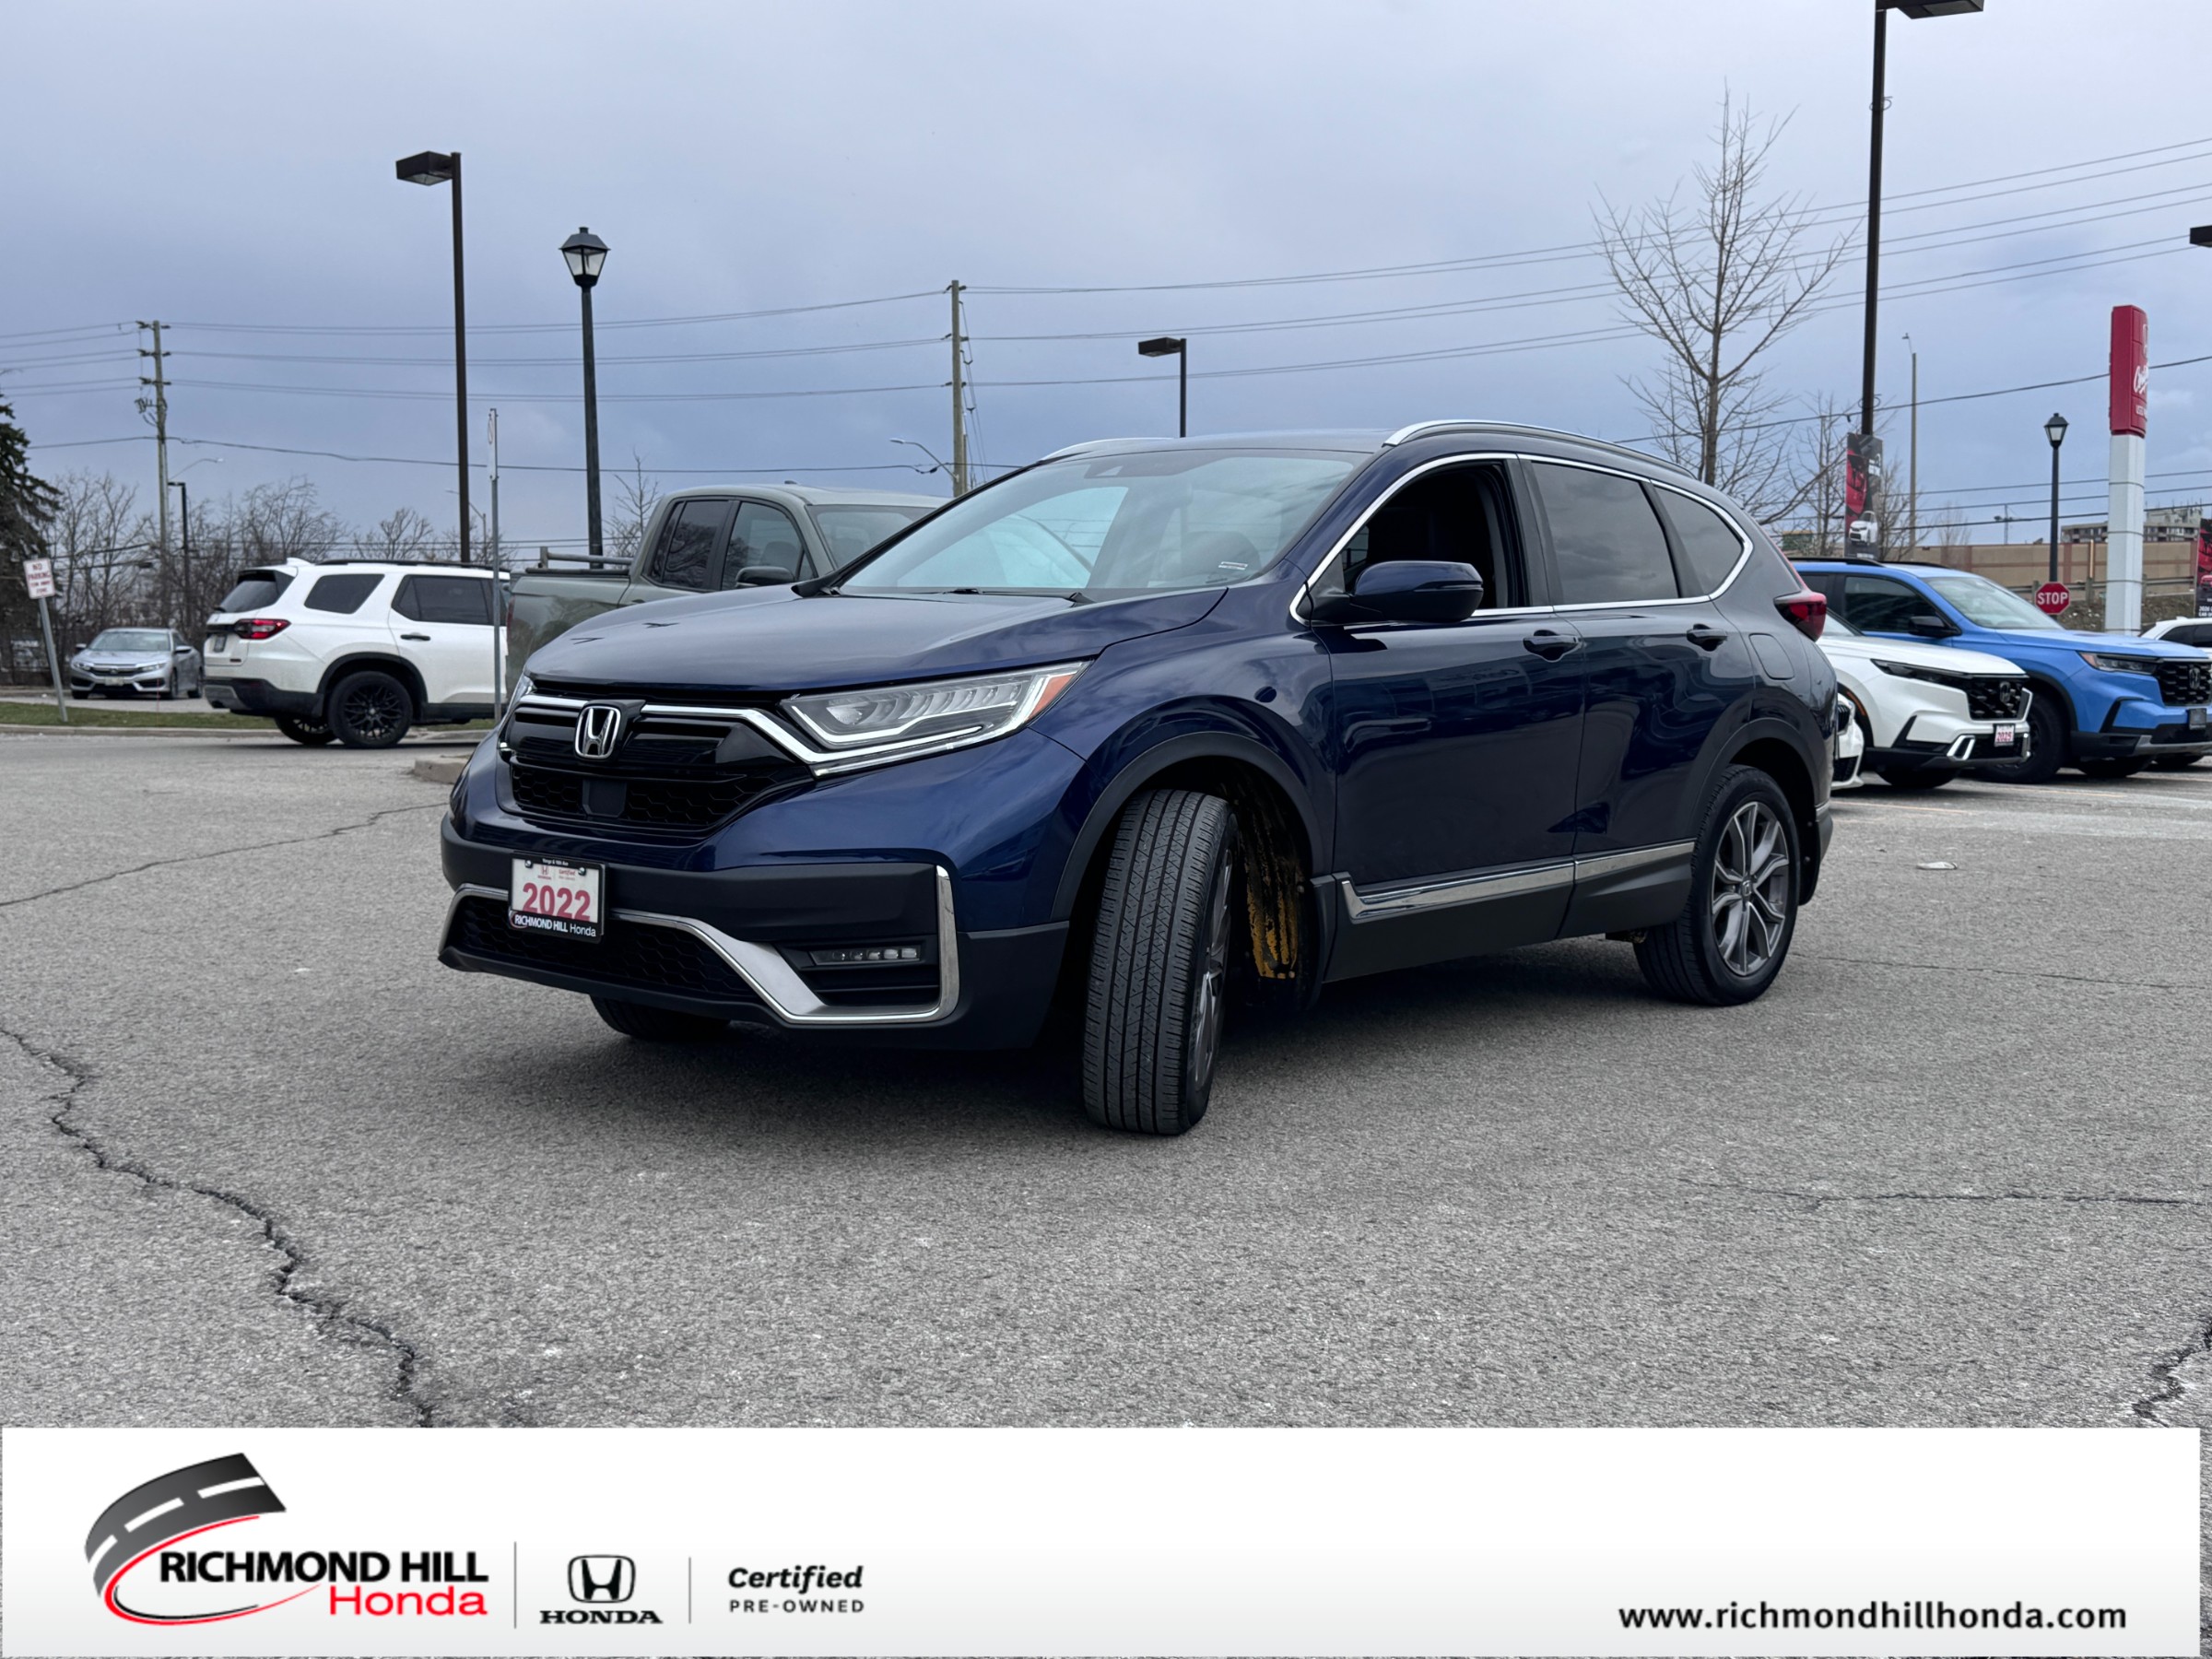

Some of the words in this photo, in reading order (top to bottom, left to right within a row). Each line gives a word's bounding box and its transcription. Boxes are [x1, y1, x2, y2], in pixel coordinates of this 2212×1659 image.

[2037, 592, 2068, 605] STOP
[523, 882, 591, 922] 2022
[514, 914, 553, 930] RICHMOND
[553, 920, 568, 933] HILL
[570, 922, 596, 937] Honda
